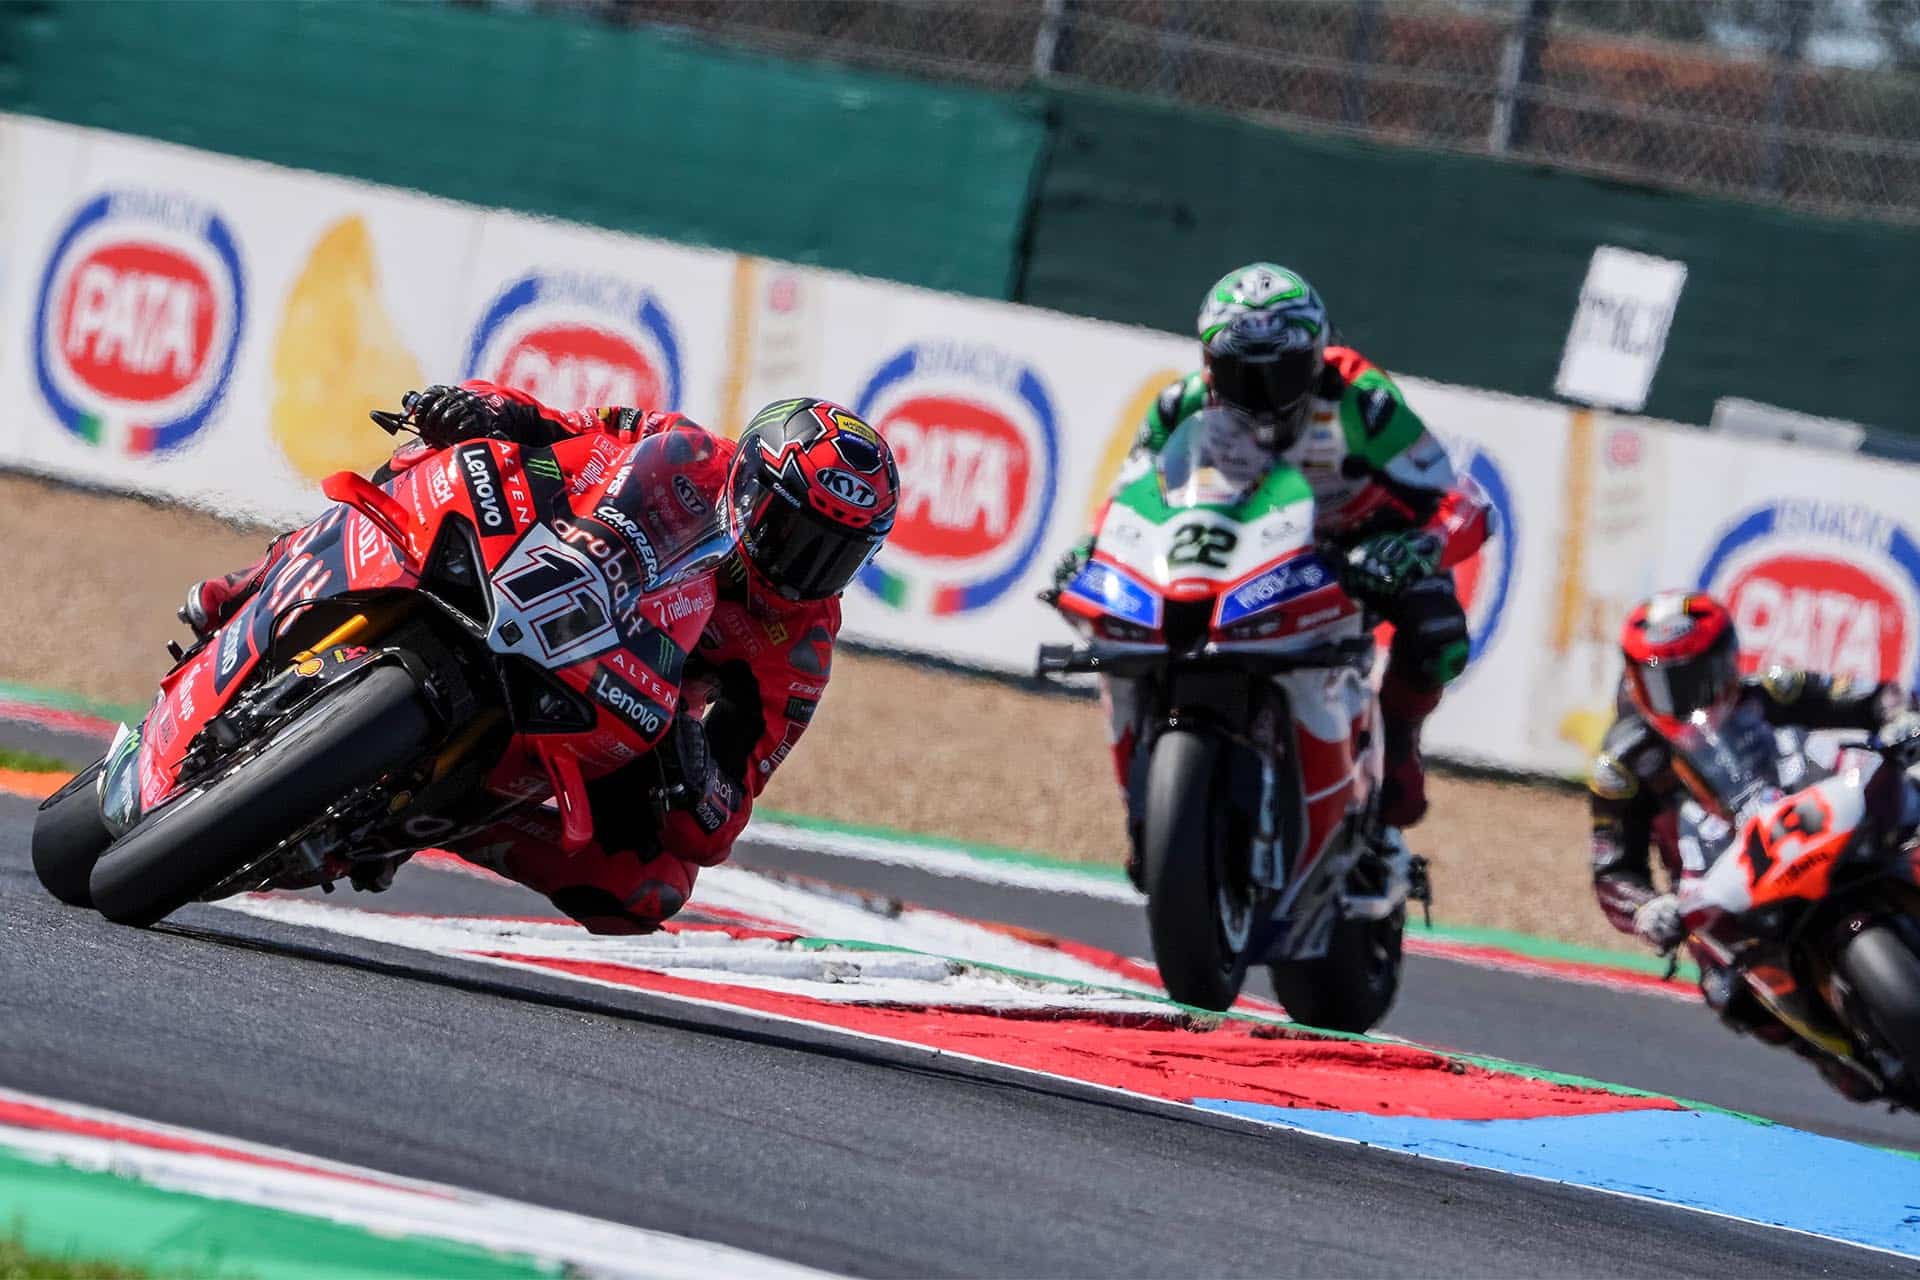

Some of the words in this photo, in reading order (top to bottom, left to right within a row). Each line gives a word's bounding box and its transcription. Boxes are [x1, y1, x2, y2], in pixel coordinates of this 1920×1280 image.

[67, 262, 199, 379] PATA
[463, 449, 503, 527] Lenovo
[498, 442, 530, 524] ALTEN
[822, 470, 875, 505] KYT
[884, 421, 1007, 536] PATA
[553, 518, 644, 638] aruba.it
[597, 505, 660, 591] CARRERA
[1167, 523, 1238, 569] 22
[668, 590, 693, 625] riello
[596, 673, 661, 733] Lenovo
[611, 653, 677, 708] ALTEN
